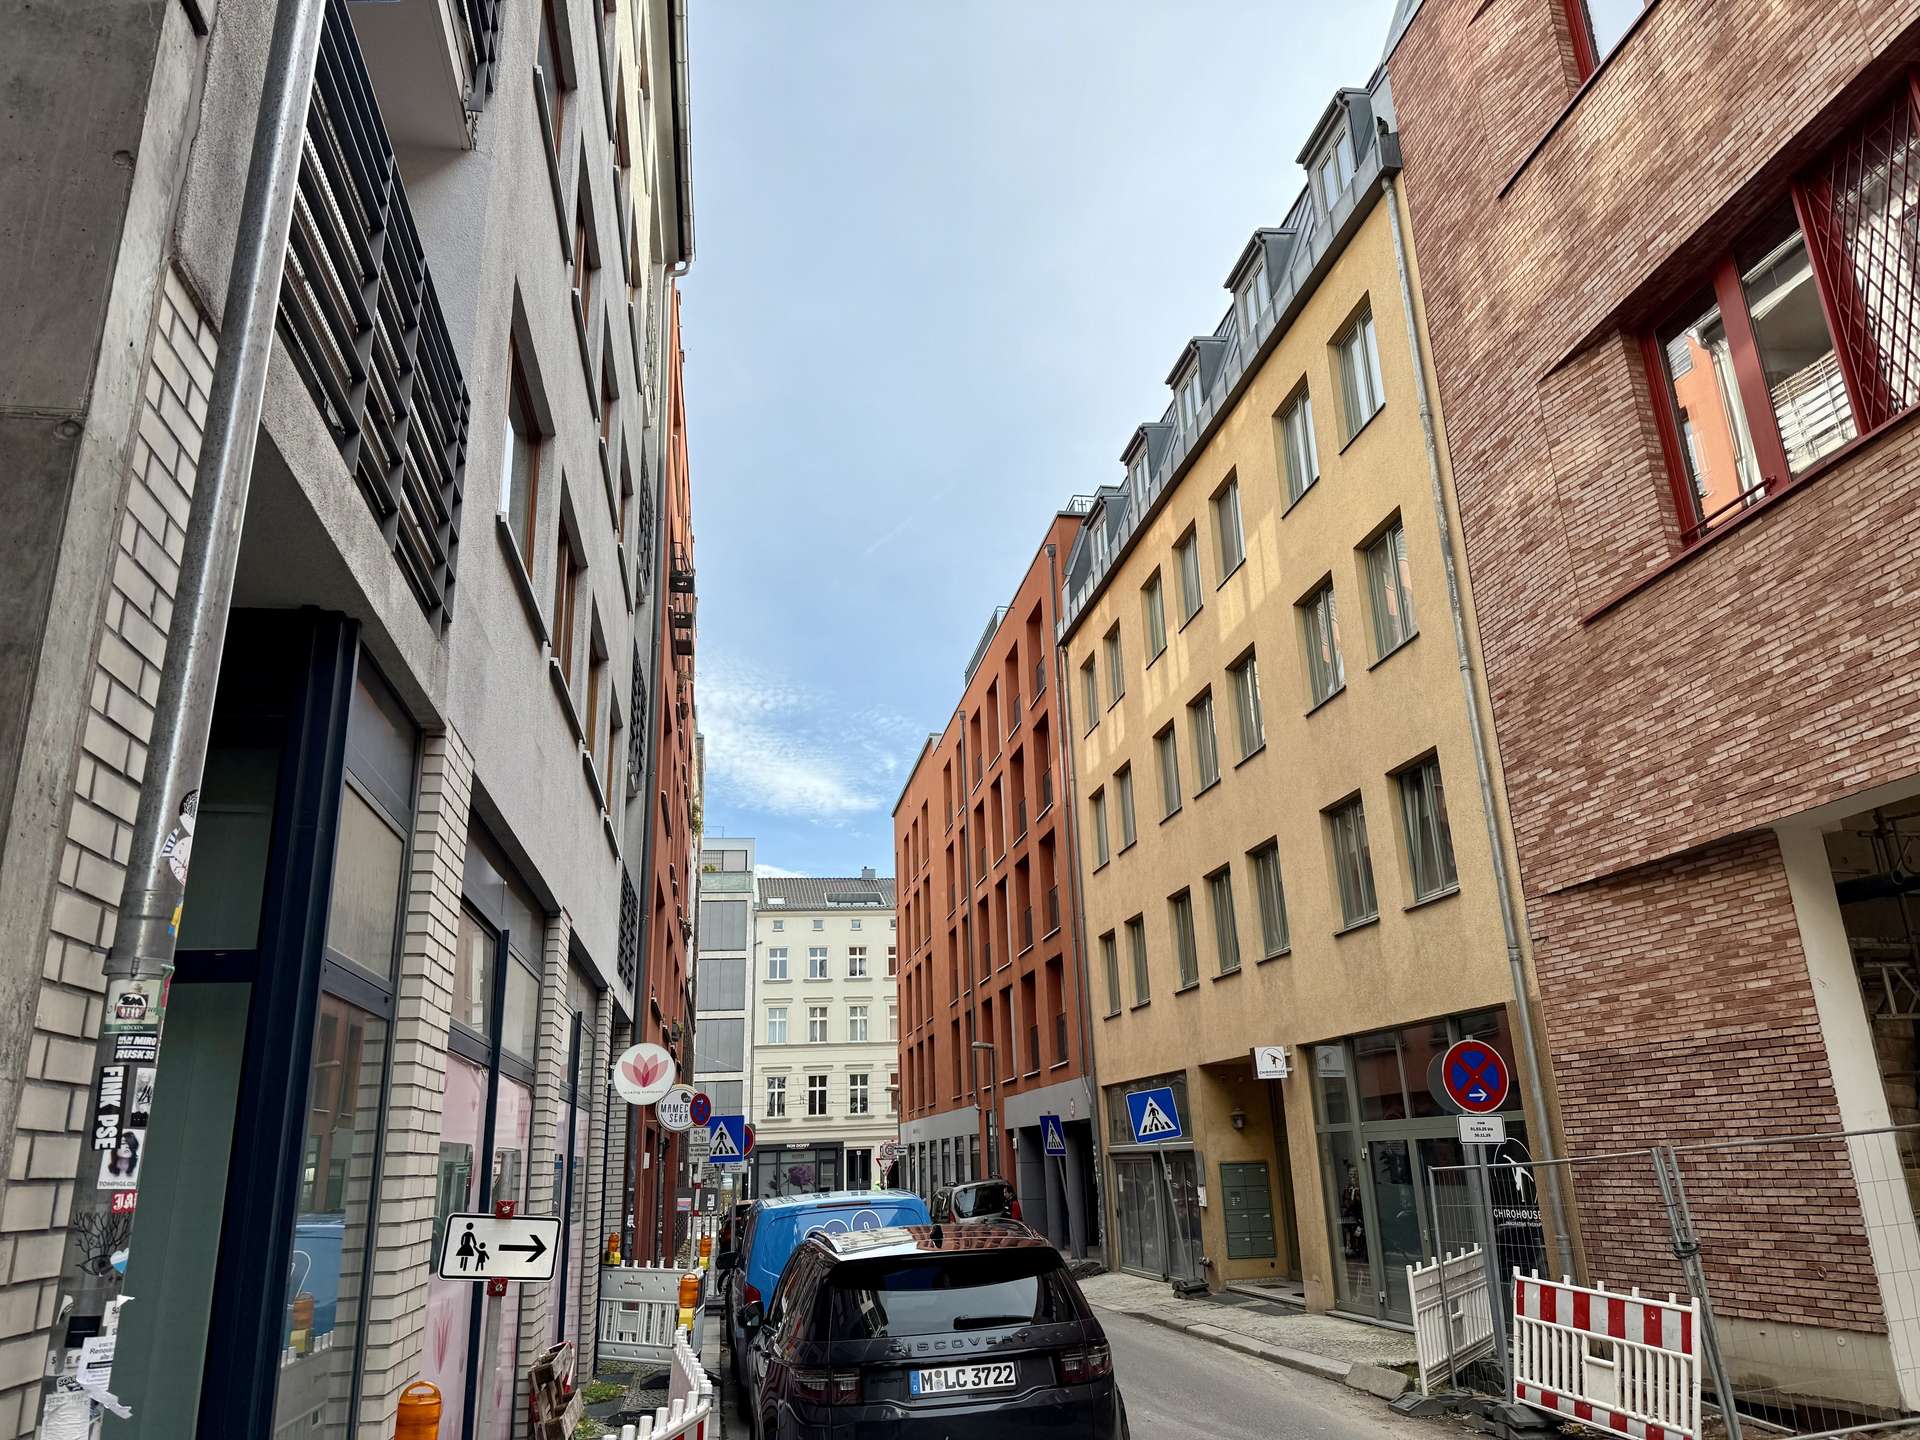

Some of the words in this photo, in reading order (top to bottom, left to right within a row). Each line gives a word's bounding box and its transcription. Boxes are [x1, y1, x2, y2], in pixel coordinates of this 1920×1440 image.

[99, 1066, 125, 1108] FINK
[94, 1114, 120, 1150] PSE
[890, 1331, 1029, 1353] DISCOVERY
[919, 1371, 935, 1392] M
[943, 1368, 969, 1390] LC
[971, 1364, 1015, 1387] 3722
